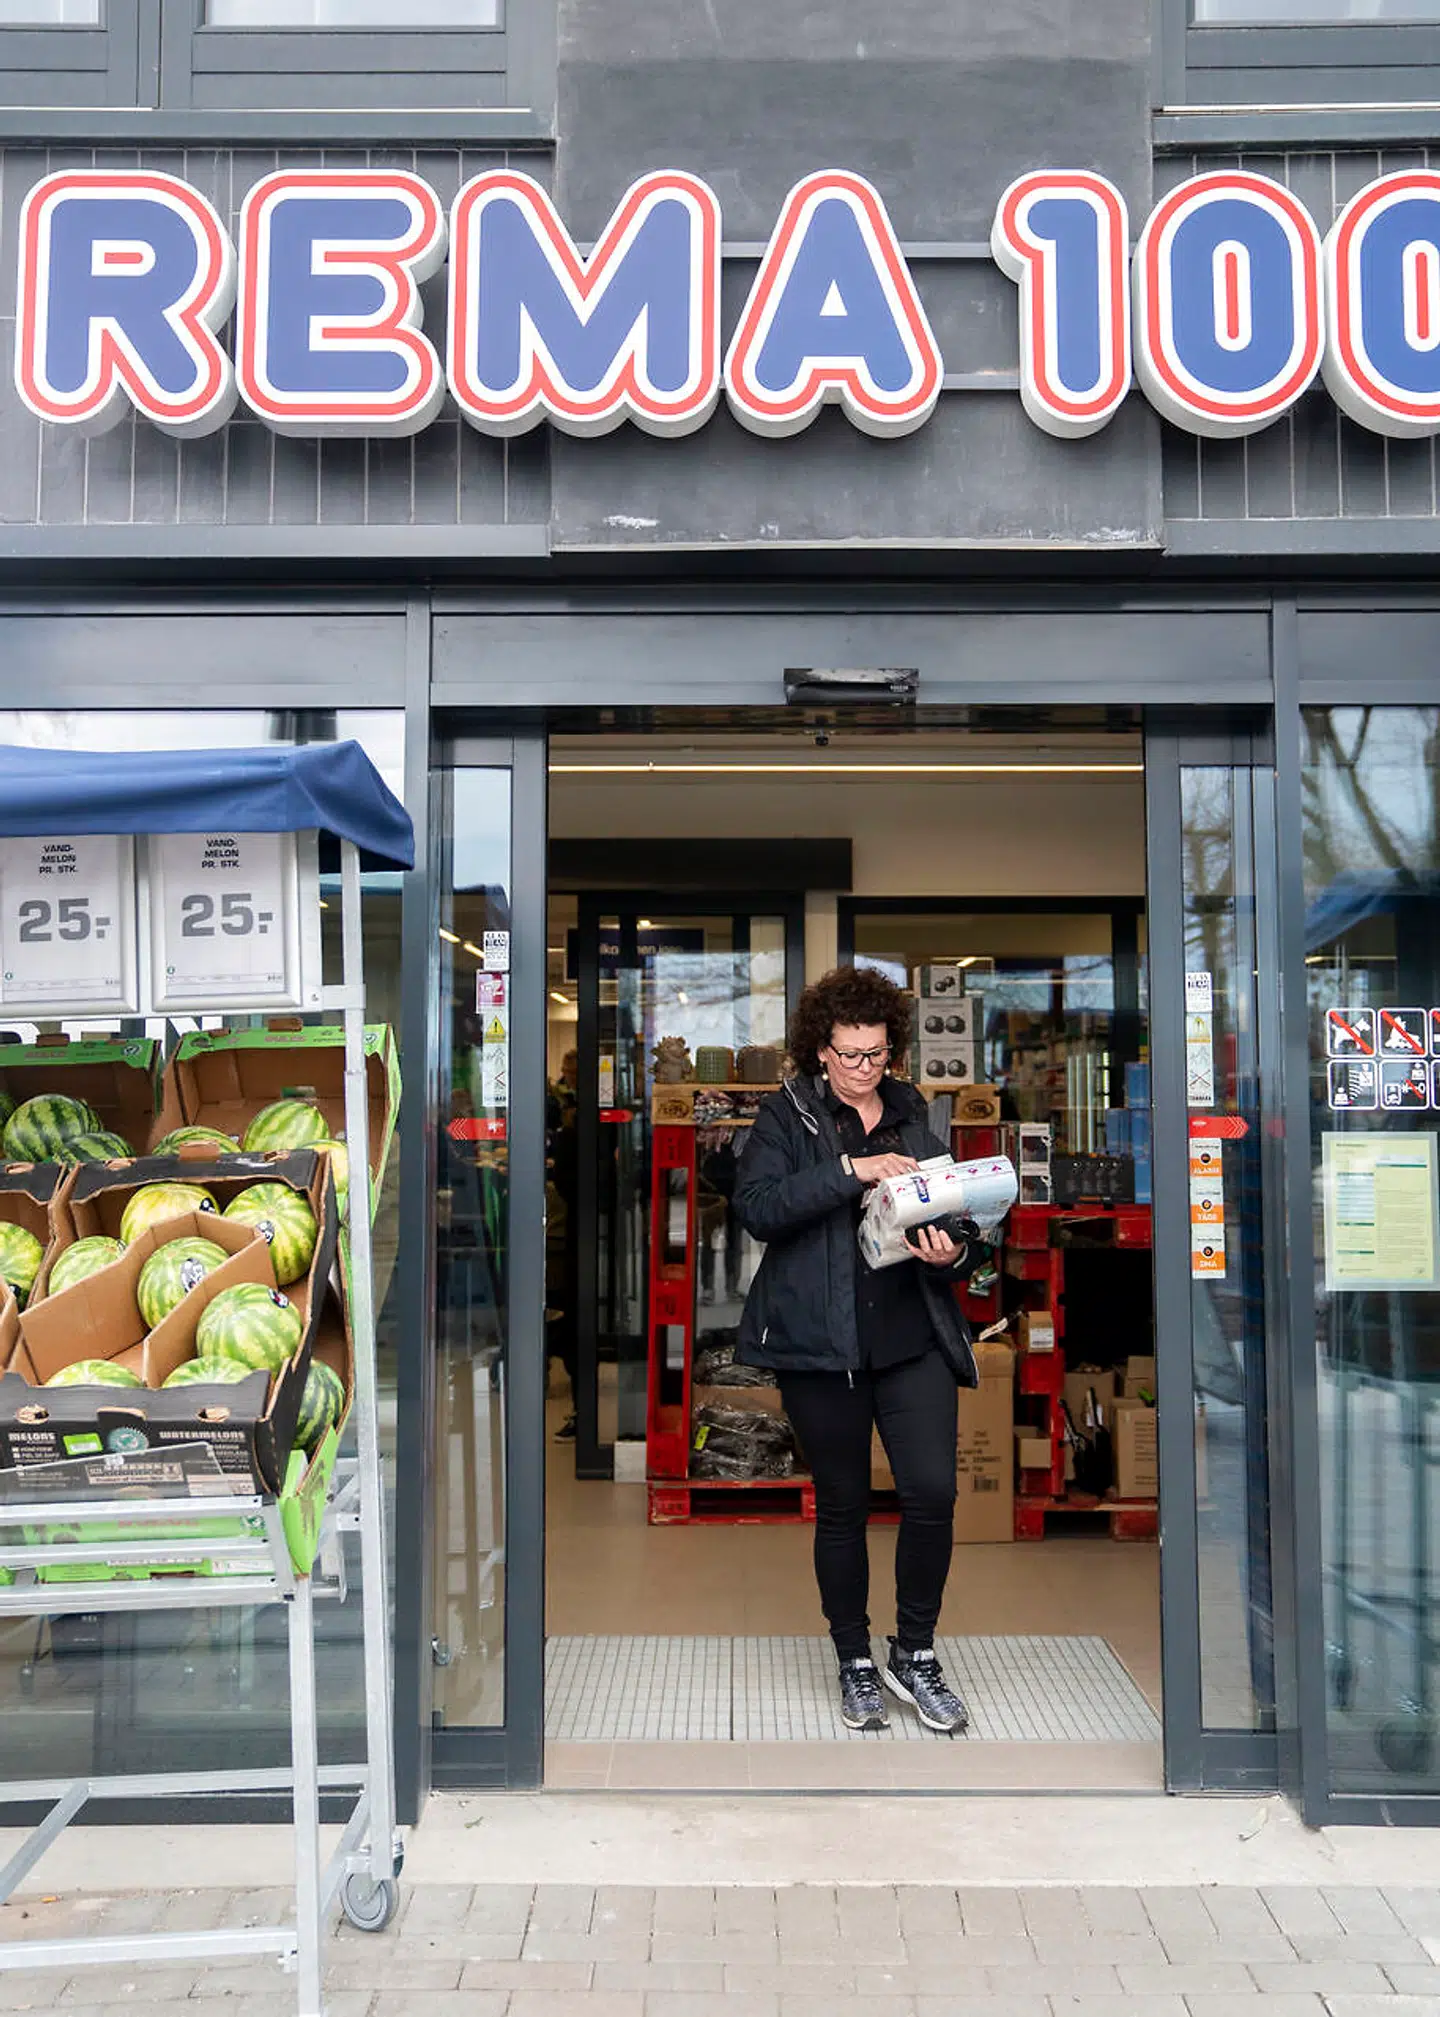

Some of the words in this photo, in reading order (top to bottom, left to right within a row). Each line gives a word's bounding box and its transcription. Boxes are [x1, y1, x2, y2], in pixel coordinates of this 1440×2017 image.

[14, 168, 944, 428] REMA
[206, 838, 237, 848] VAND-
[42, 844, 74, 853] VAND-
[204, 849, 239, 858] MELON
[41, 854, 76, 864] MELON
